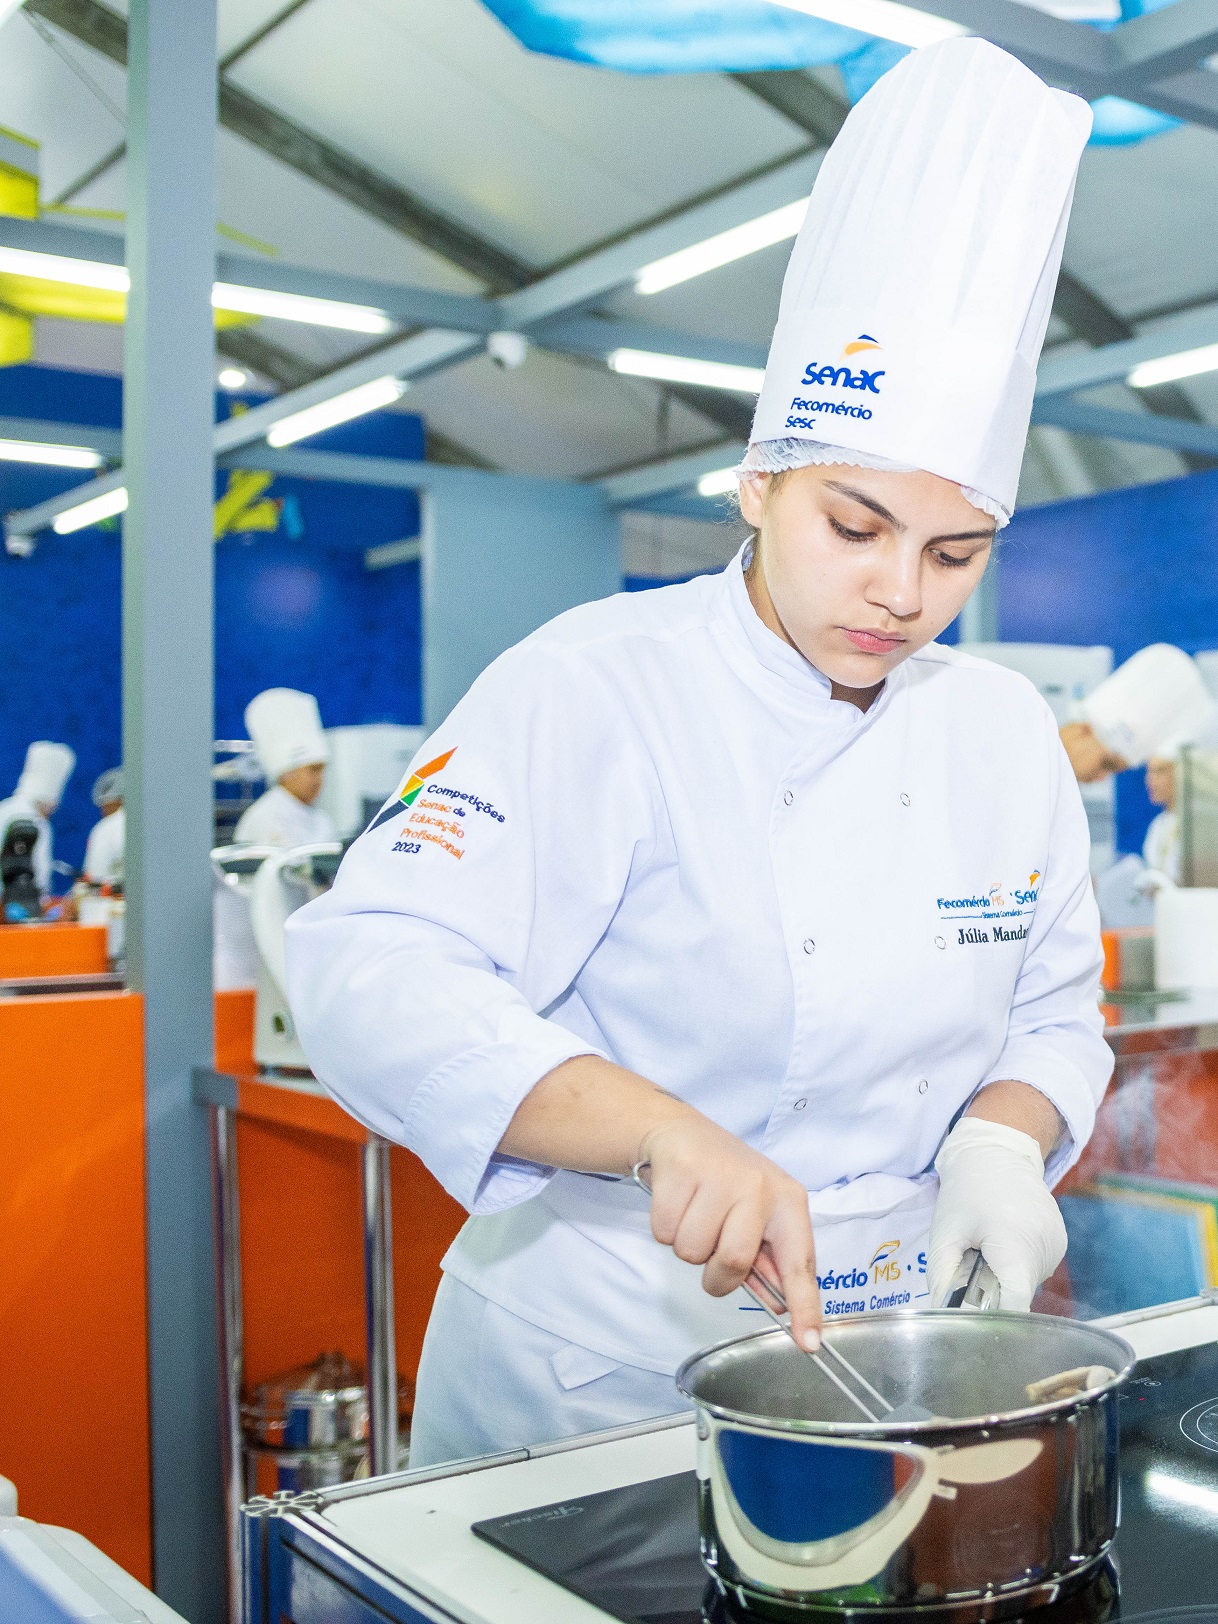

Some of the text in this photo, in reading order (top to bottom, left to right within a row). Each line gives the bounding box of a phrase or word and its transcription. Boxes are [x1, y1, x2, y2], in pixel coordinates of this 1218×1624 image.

[790, 397, 873, 420] Fecomércio
[417, 798, 466, 817] Senac de
[427, 784, 506, 823] Competições
[409, 812, 465, 839] Educação
[391, 841, 421, 854] 2023
[399, 827, 465, 860] Profissional
[937, 895, 991, 909] Fecomércio
[958, 927, 989, 945] Júlia
[874, 1261, 901, 1284] MS
[824, 1290, 911, 1315] Sistema Comércio
